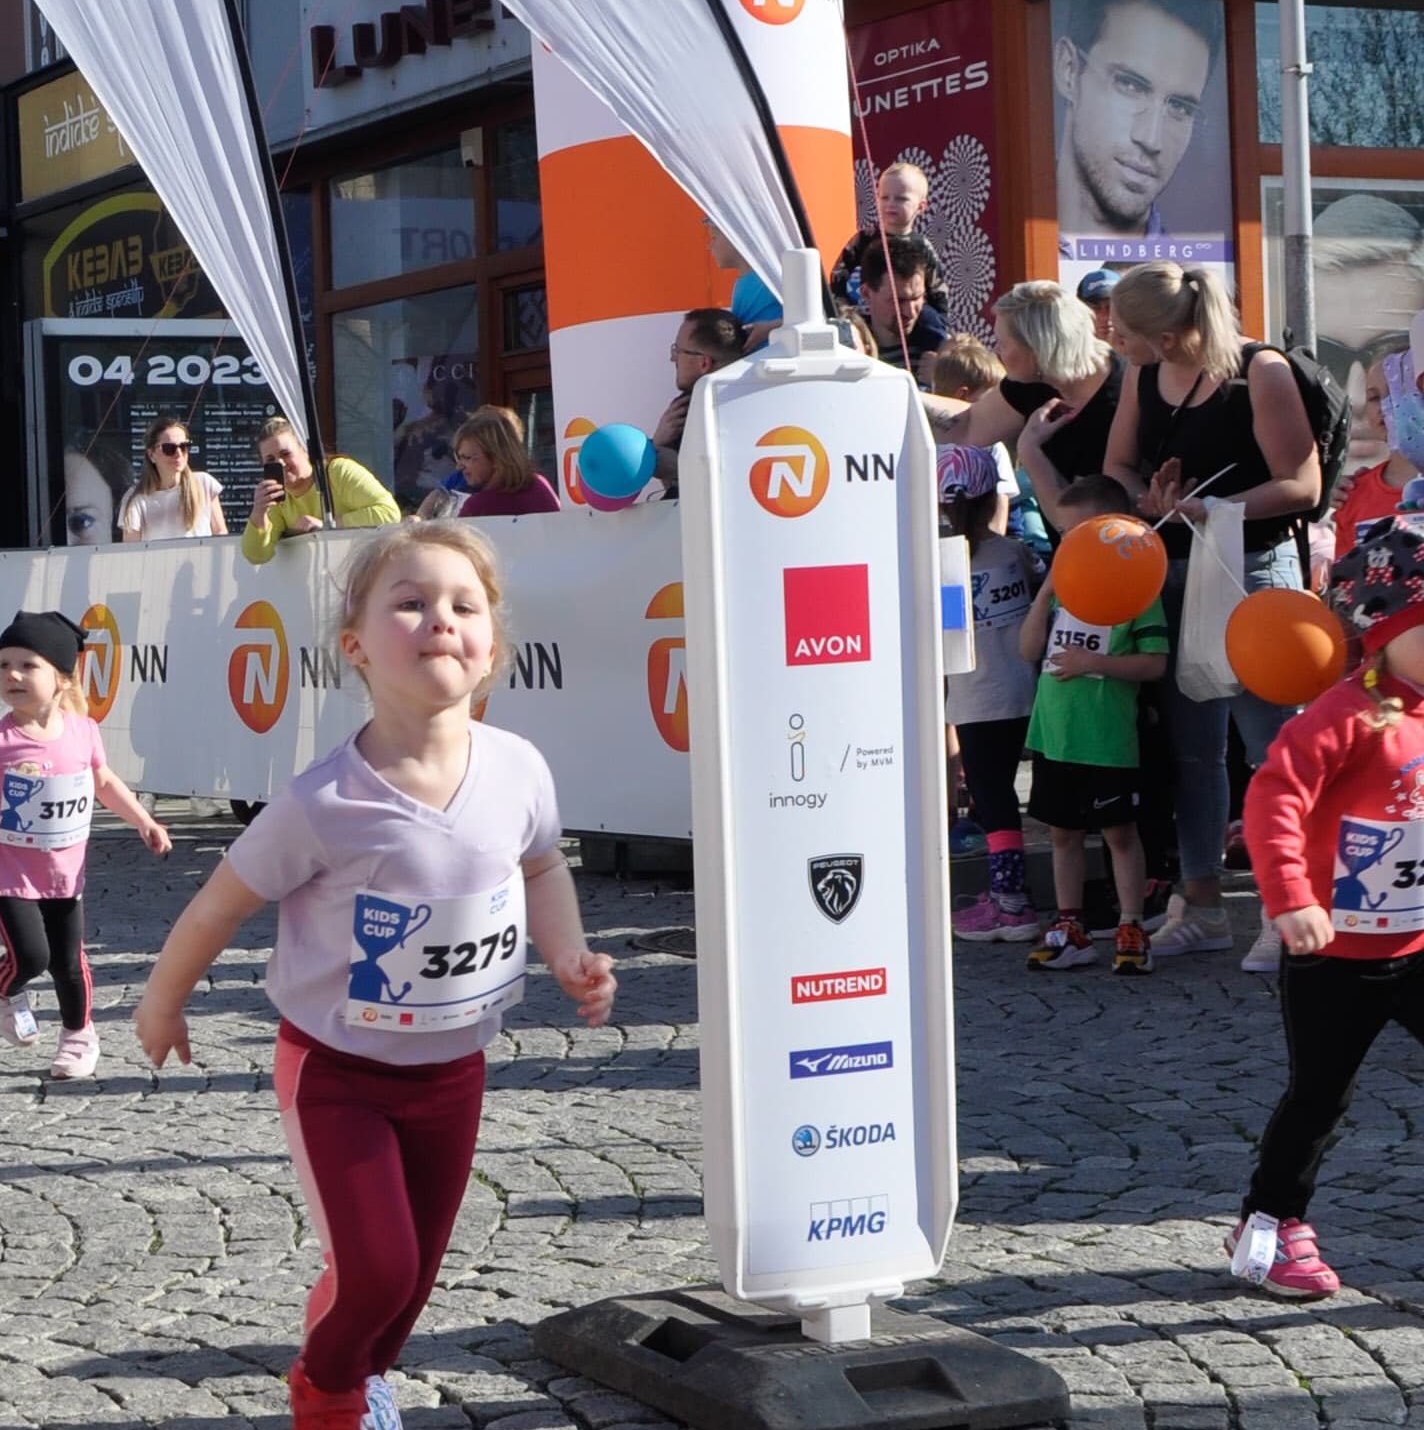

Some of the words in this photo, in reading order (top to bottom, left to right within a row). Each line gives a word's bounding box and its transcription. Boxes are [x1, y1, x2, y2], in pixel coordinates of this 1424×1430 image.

[874, 38, 940, 66] OPTIKA
[1080, 244, 1193, 259] LINDBERG
[68, 355, 135, 386] 04
[147, 354, 269, 386] 2023
[844, 453, 894, 482] NN
[989, 581, 1025, 605] 3201
[794, 634, 862, 658] AVON
[1053, 629, 1100, 651] 3156
[130, 645, 168, 683] NN
[300, 647, 341, 689] NN
[510, 642, 563, 689] NN
[856, 746, 894, 756] Powered
[856, 759, 868, 769] by
[871, 757, 893, 767] MVM
[39, 796, 88, 820] 3170
[769, 792, 827, 811] innogy
[1345, 832, 1379, 846] KIDS
[812, 858, 859, 869] PEUGEOT
[1345, 845, 1375, 858] CUP
[363, 907, 401, 925] KIDS
[363, 923, 397, 939] CUP
[419, 924, 517, 980] 3279
[796, 974, 883, 998] NUTREND
[824, 1122, 896, 1149] ŠKODA
[807, 1211, 886, 1242] KPMG
